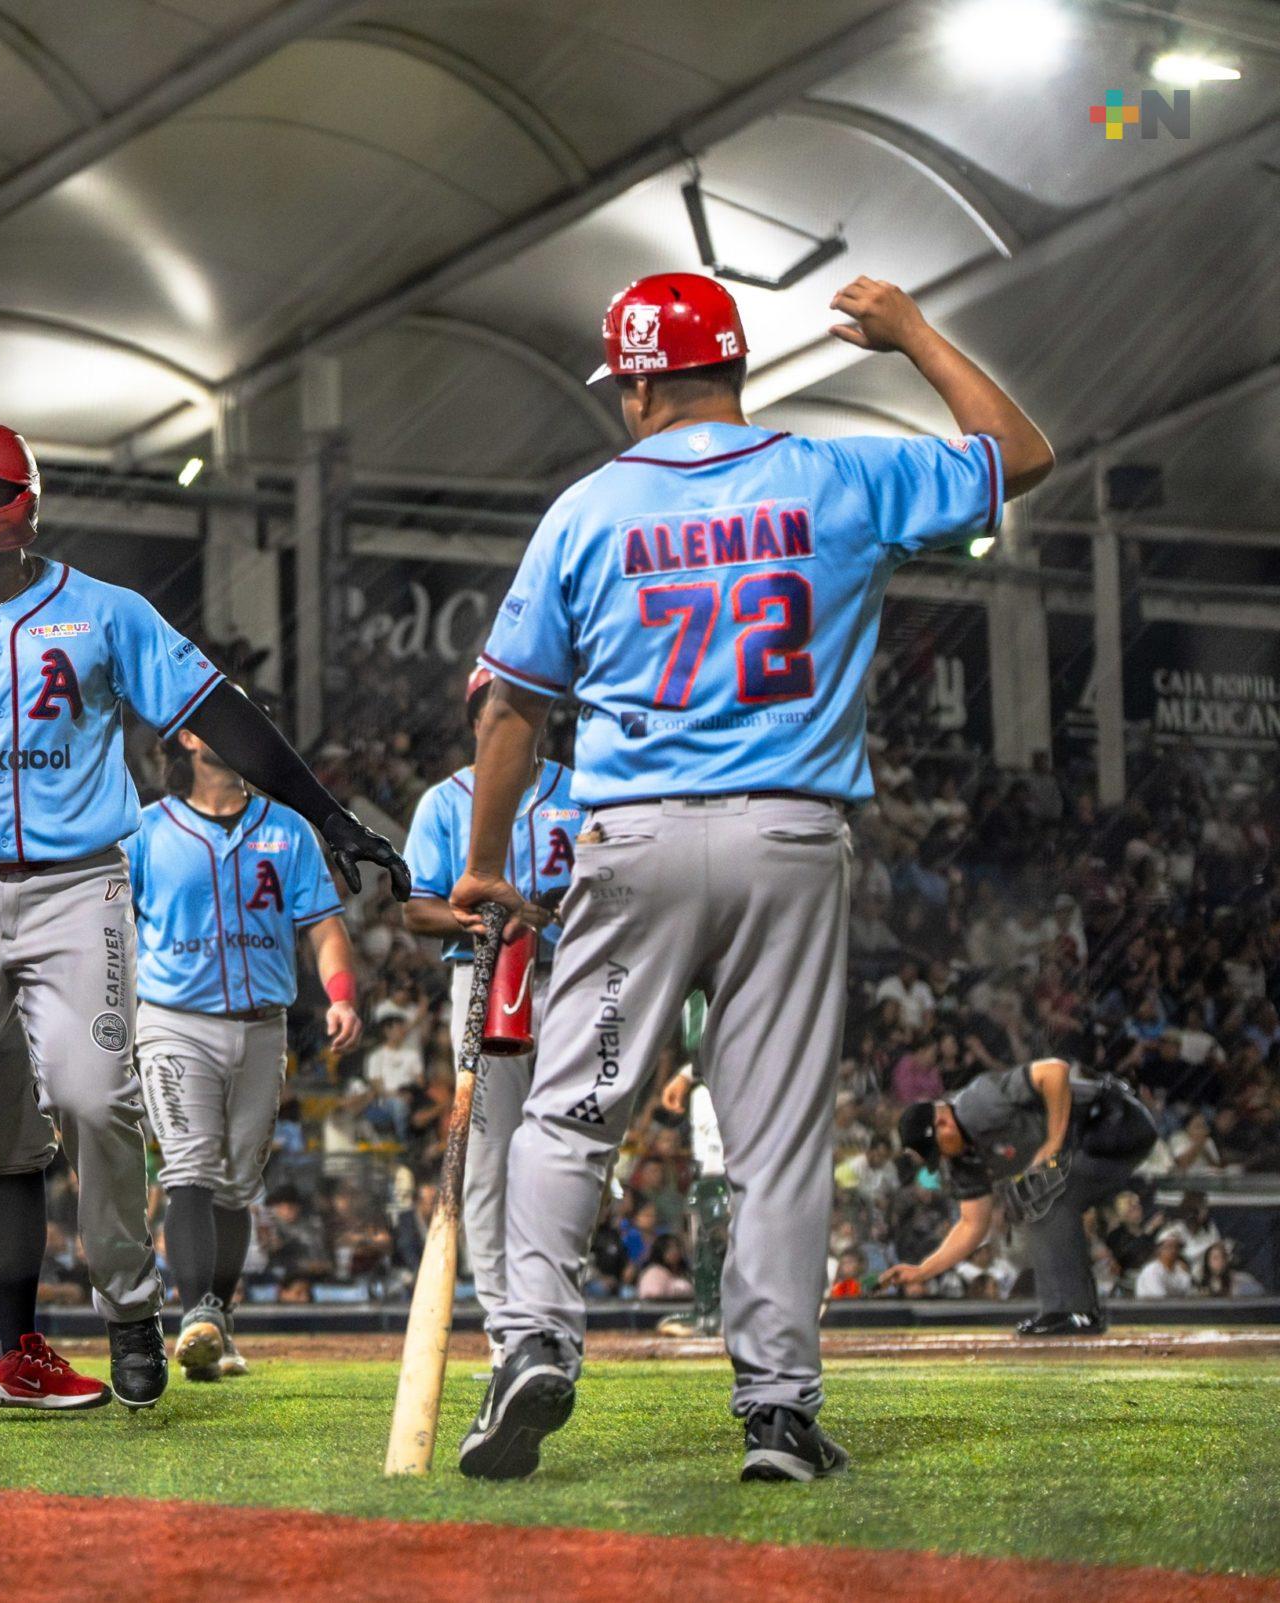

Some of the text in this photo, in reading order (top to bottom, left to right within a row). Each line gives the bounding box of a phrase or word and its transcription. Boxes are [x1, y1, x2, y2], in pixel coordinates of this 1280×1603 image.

[620, 355, 634, 369] La
[715, 332, 738, 357] 72
[624, 500, 813, 575] ALEMÁN
[29, 624, 89, 635] VERACRUZ
[638, 569, 816, 711] 72
[27, 648, 84, 720] A
[540, 827, 576, 877] A
[245, 860, 284, 913] A
[103, 926, 119, 1007] CAFIVER
[593, 960, 629, 1087] Totalplay
